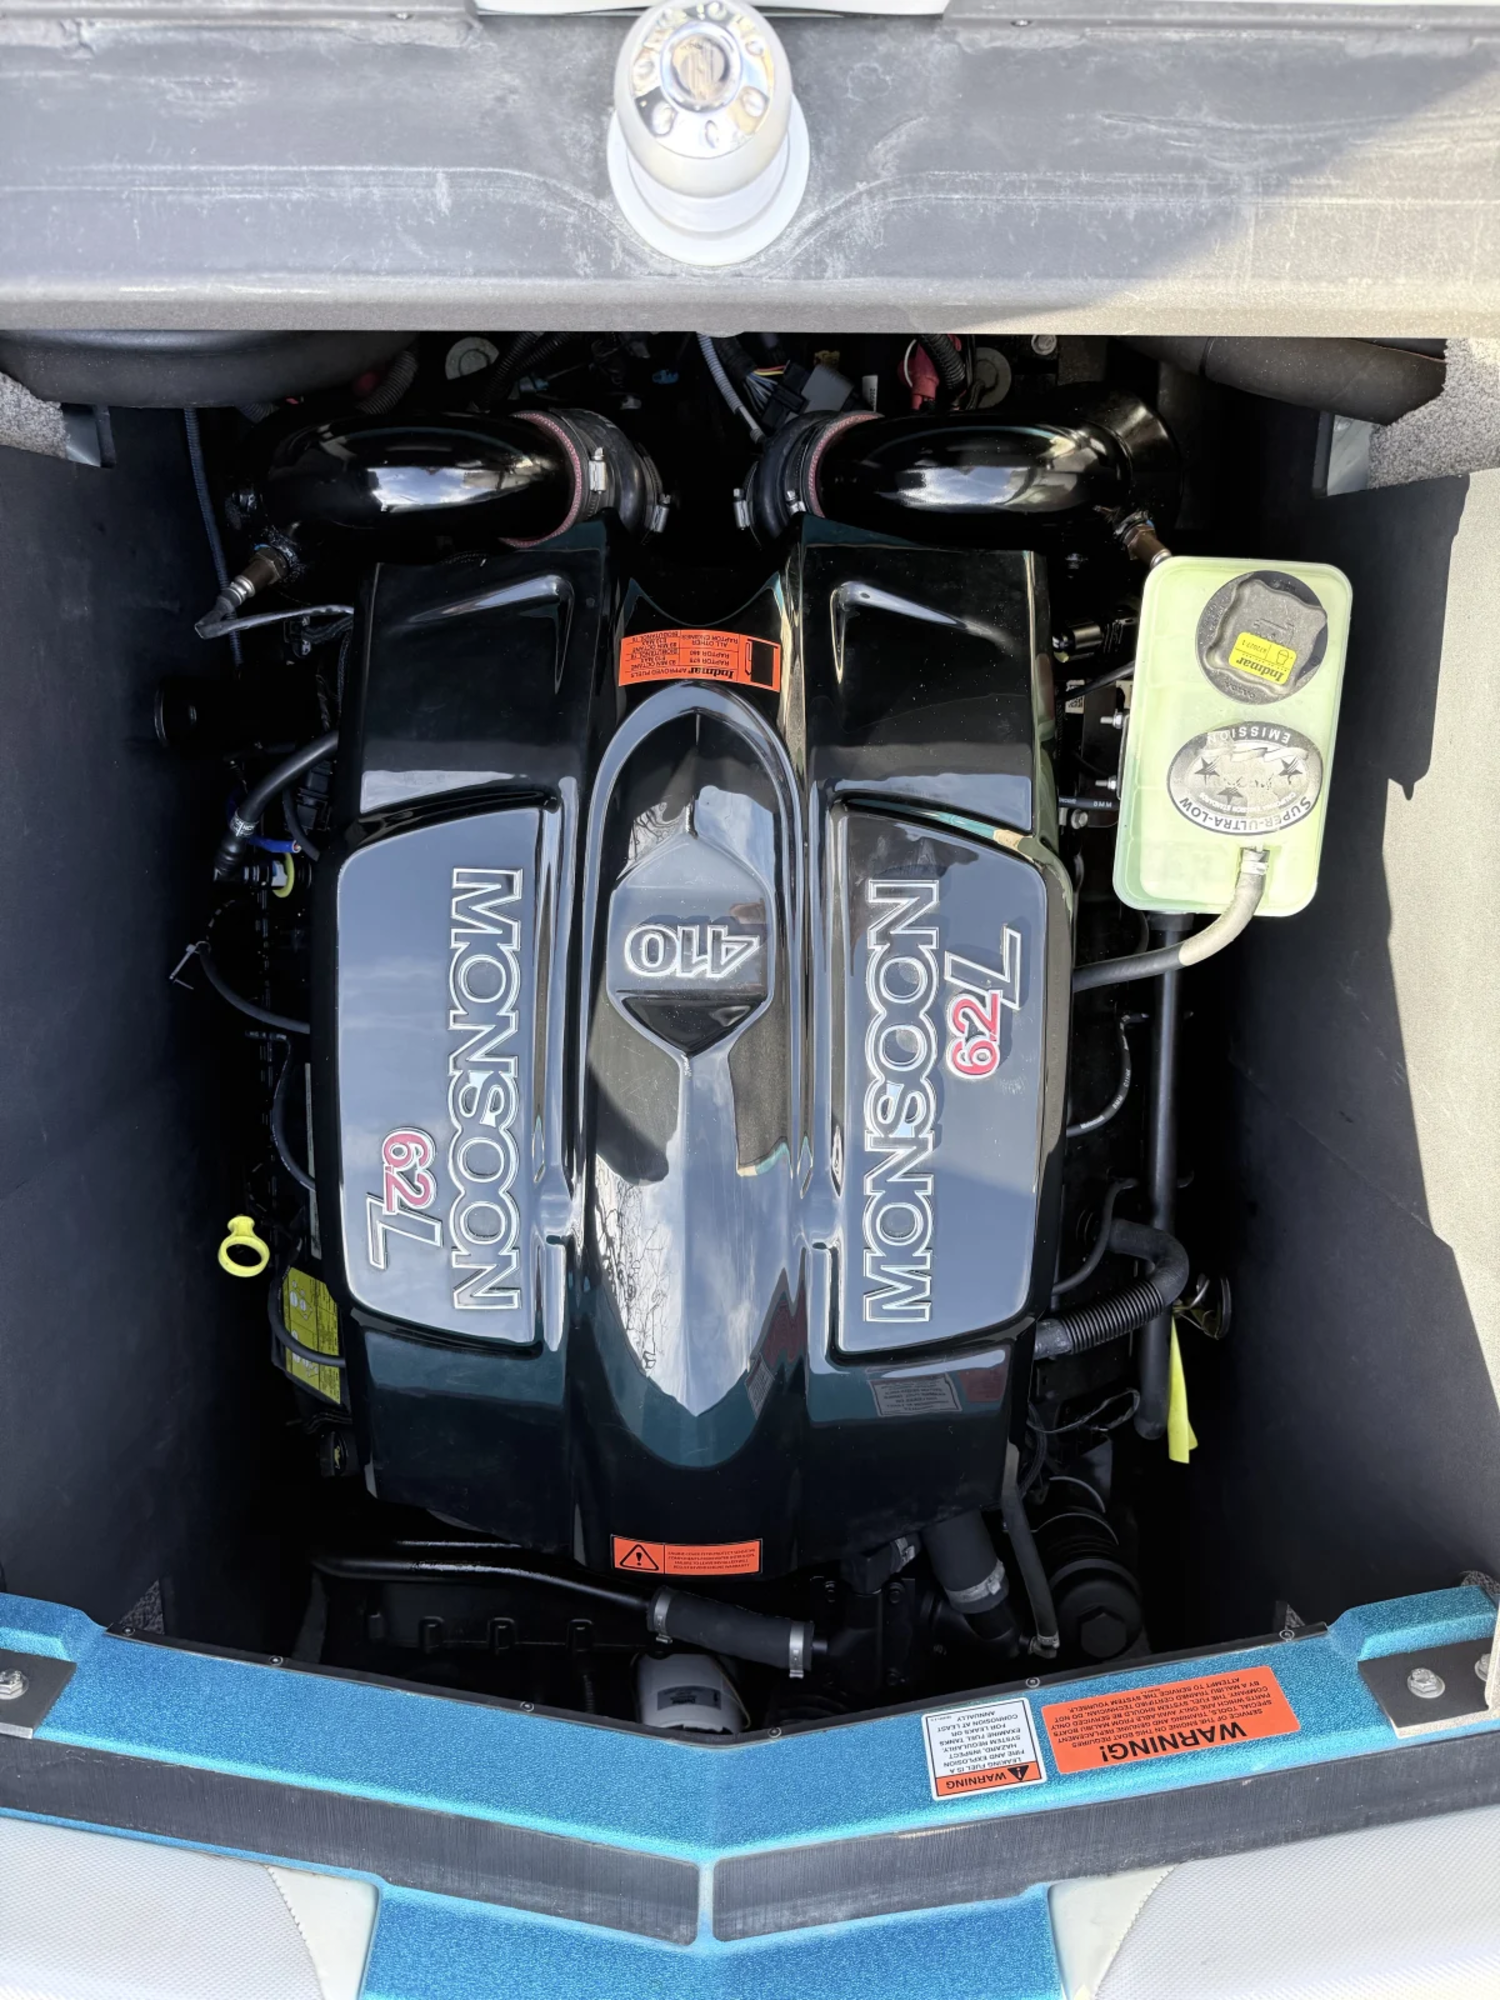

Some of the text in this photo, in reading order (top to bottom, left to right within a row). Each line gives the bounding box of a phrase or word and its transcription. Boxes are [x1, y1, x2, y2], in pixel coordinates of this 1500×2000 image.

[711, 635, 737, 643] RAPTOR
[702, 650, 728, 658] RAPTOR
[630, 662, 654, 670] OCTANE
[651, 667, 686, 675] APPROVED
[1236, 657, 1284, 683] Indmar
[688, 667, 733, 678] Indmar
[1207, 726, 1291, 747] EMISSION
[1179, 796, 1311, 831] SUPER-ULTRA-LOW
[624, 924, 760, 978] 410
[448, 867, 523, 1309] MONSOON
[862, 878, 940, 1324] MONSOON
[1204, 1676, 1240, 1687] ATTEMPT
[1158, 1685, 1192, 1696] SERVICE
[1209, 1683, 1240, 1694] MALIBU
[1109, 1695, 1141, 1705] SYSTEM
[1174, 1689, 1208, 1700] TRAINED
[1189, 1696, 1210, 1704] FUEL
[1210, 1693, 1226, 1701] THE
[1134, 1695, 1174, 1708] CERTIFIED
[1156, 1700, 1189, 1711] SYSTEM
[1238, 1698, 1272, 1709] SPECIAL
[956, 1710, 995, 1722] ANNUALLY
[1052, 1691, 1271, 1737] PARTS WHICH ARE ONLY AVAILABLE FROM MALIBU BOATS
[1123, 1706, 1156, 1717] SHOULD
[1170, 1710, 1207, 1722] TRAINING
[1228, 1707, 1263, 1719] SERVICE
[972, 1713, 1018, 1726] CORROSION
[1053, 1715, 1071, 1723] NOT
[1072, 1714, 1111, 1727] SERVICED
[1151, 1718, 1169, 1726] AND
[1167, 1719, 1198, 1730] ENGINE
[1198, 1716, 1214, 1724] THE
[936, 1723, 960, 1732] LEAST
[964, 1725, 988, 1734] LEAKS
[989, 1722, 1006, 1730] FOR
[1050, 1722, 1071, 1731] ONLY
[1115, 1721, 1151, 1733] GENUINE
[1153, 1725, 1167, 1733] ON
[939, 1727, 1020, 1746] EXAMINE FUEL TANKS
[1056, 1728, 1115, 1744] REPLACEMENT
[1111, 1731, 1134, 1741] BOAT
[1134, 1728, 1152, 1736] THIS
[989, 1734, 1020, 1744] SYSTEM
[1071, 1736, 1111, 1748] REQUIRES
[1098, 1720, 1247, 1762] WARNING!
[943, 1748, 1024, 1767] FIRE AND EXPLOSION
[948, 1748, 981, 1759] INSPECT
[966, 1762, 985, 1771] FUEL
[986, 1756, 1021, 1767] LEAKING
[945, 1771, 1006, 1789] WARNING
